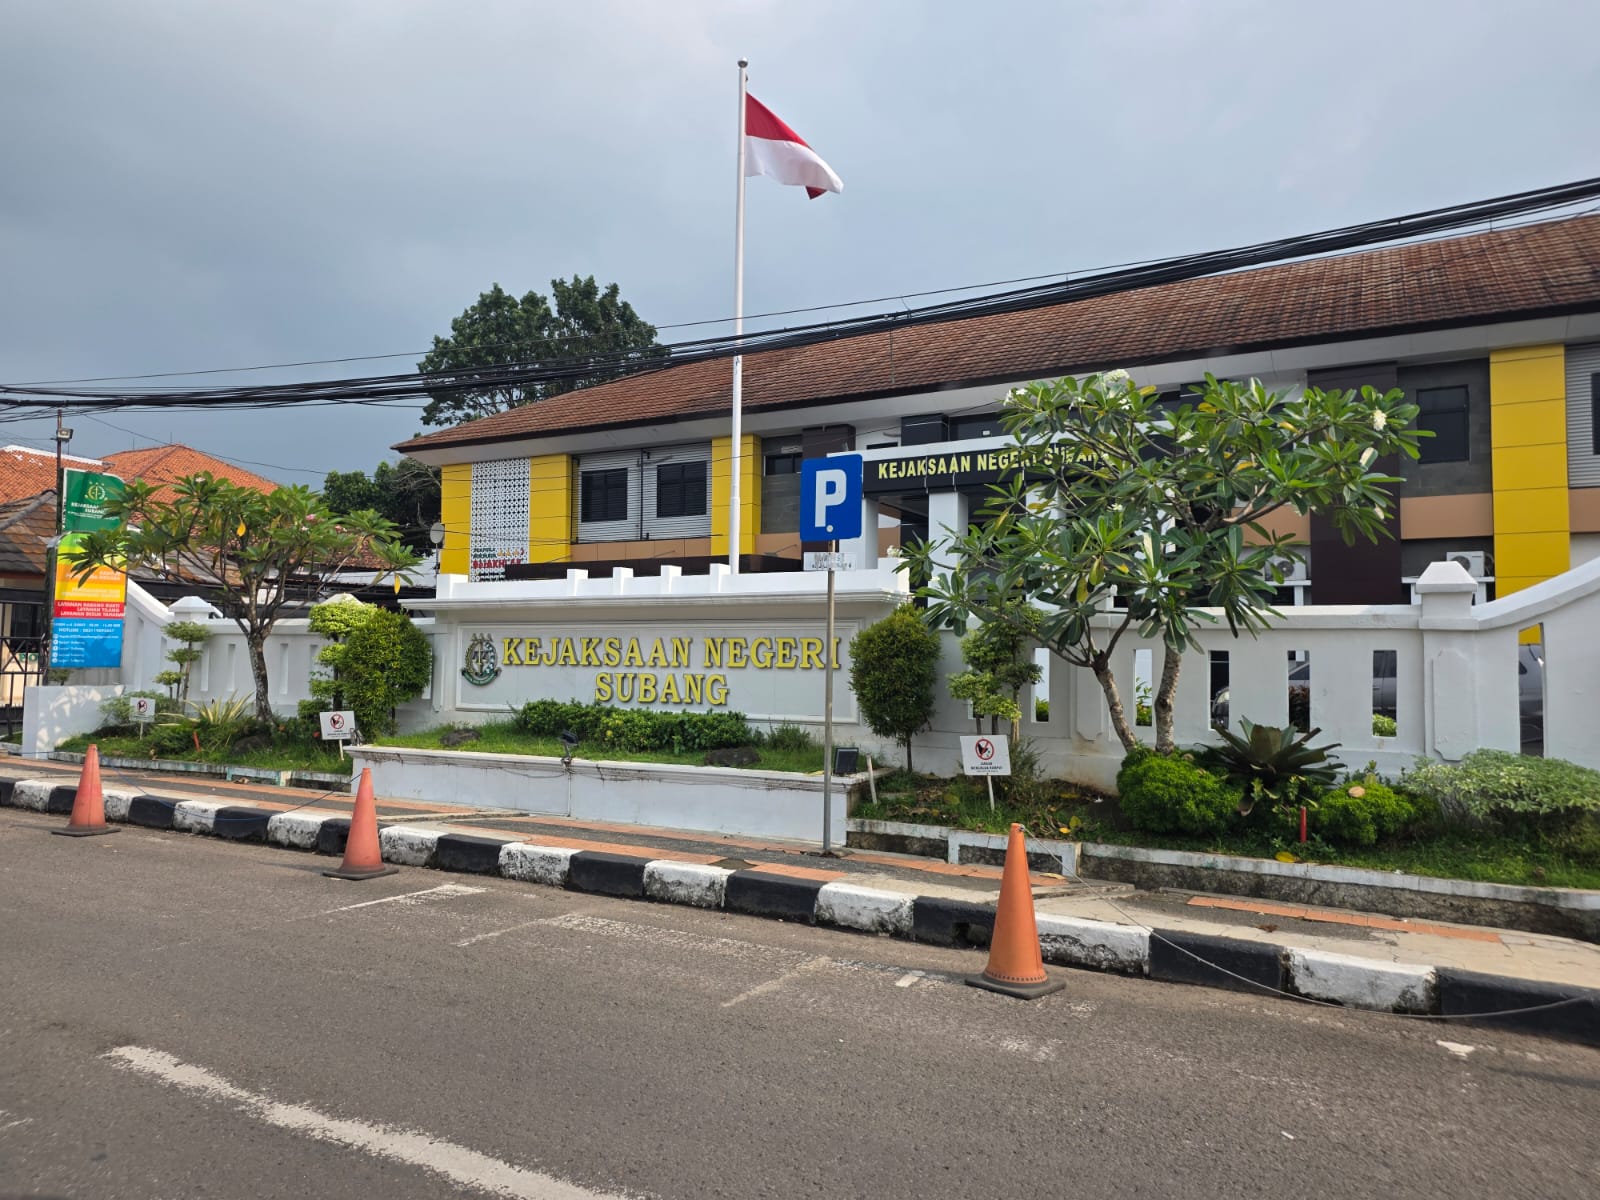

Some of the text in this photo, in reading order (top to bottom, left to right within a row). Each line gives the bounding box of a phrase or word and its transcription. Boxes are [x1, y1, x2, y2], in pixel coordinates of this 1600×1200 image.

[877, 453, 972, 480] KEJAKSAAN
[814, 468, 848, 528] P
[501, 636, 841, 671] KEJAKSAAN NEGERI
[594, 672, 729, 706] SUBANG
